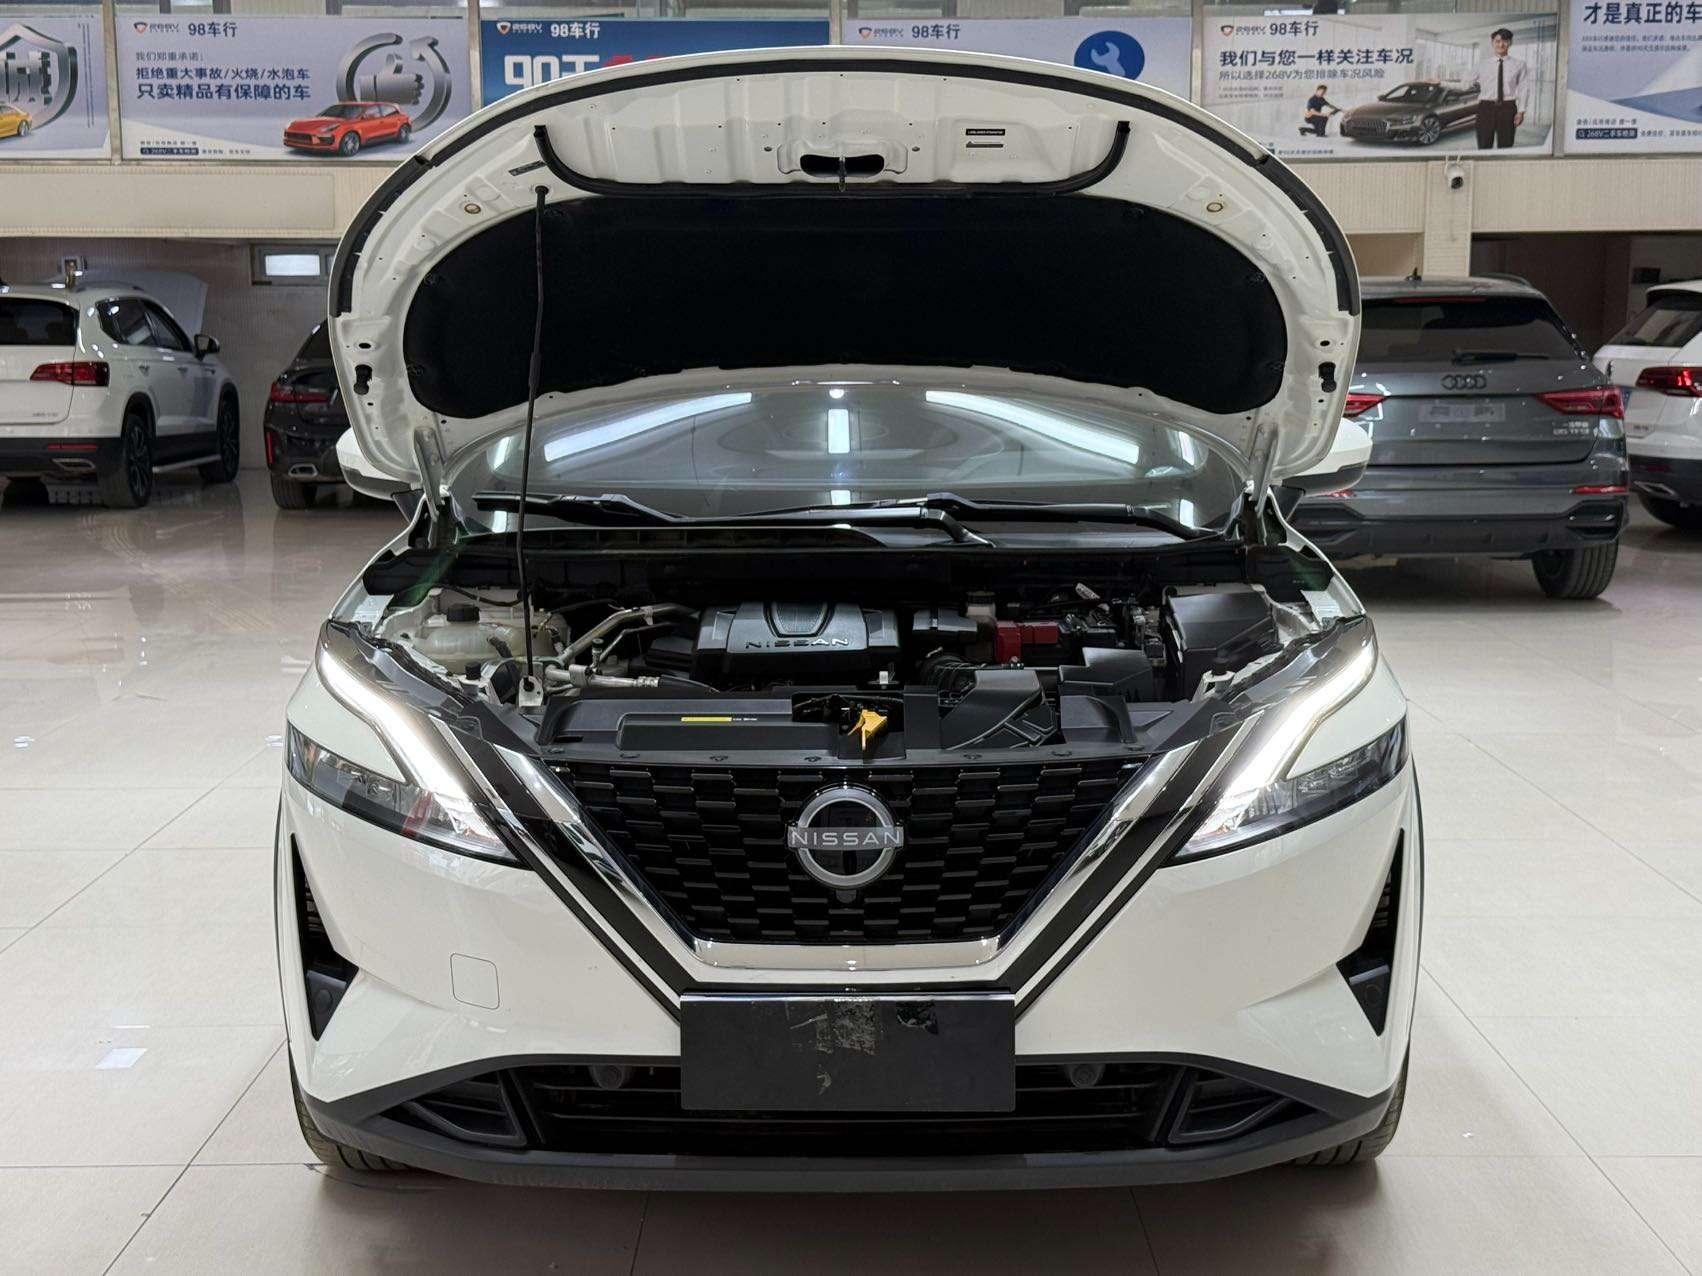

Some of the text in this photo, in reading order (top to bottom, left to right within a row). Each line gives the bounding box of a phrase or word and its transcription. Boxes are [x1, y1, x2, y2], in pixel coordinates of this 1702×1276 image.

[1583, 1, 1702, 24] 才是真正的车
[188, 22, 238, 37] 98车行
[550, 22, 600, 38] 98车行
[911, 24, 961, 39] 98车行
[1269, 21, 1319, 36] 98车行
[1220, 48, 1414, 67] 我们与您一样关注车况
[136, 67, 311, 80] 拒绝重大事故/火烧/水泡车
[137, 83, 311, 100] 只卖精品有保障的车
[745, 638, 849, 649] NISSAN
[791, 832, 900, 846] NISSAN
